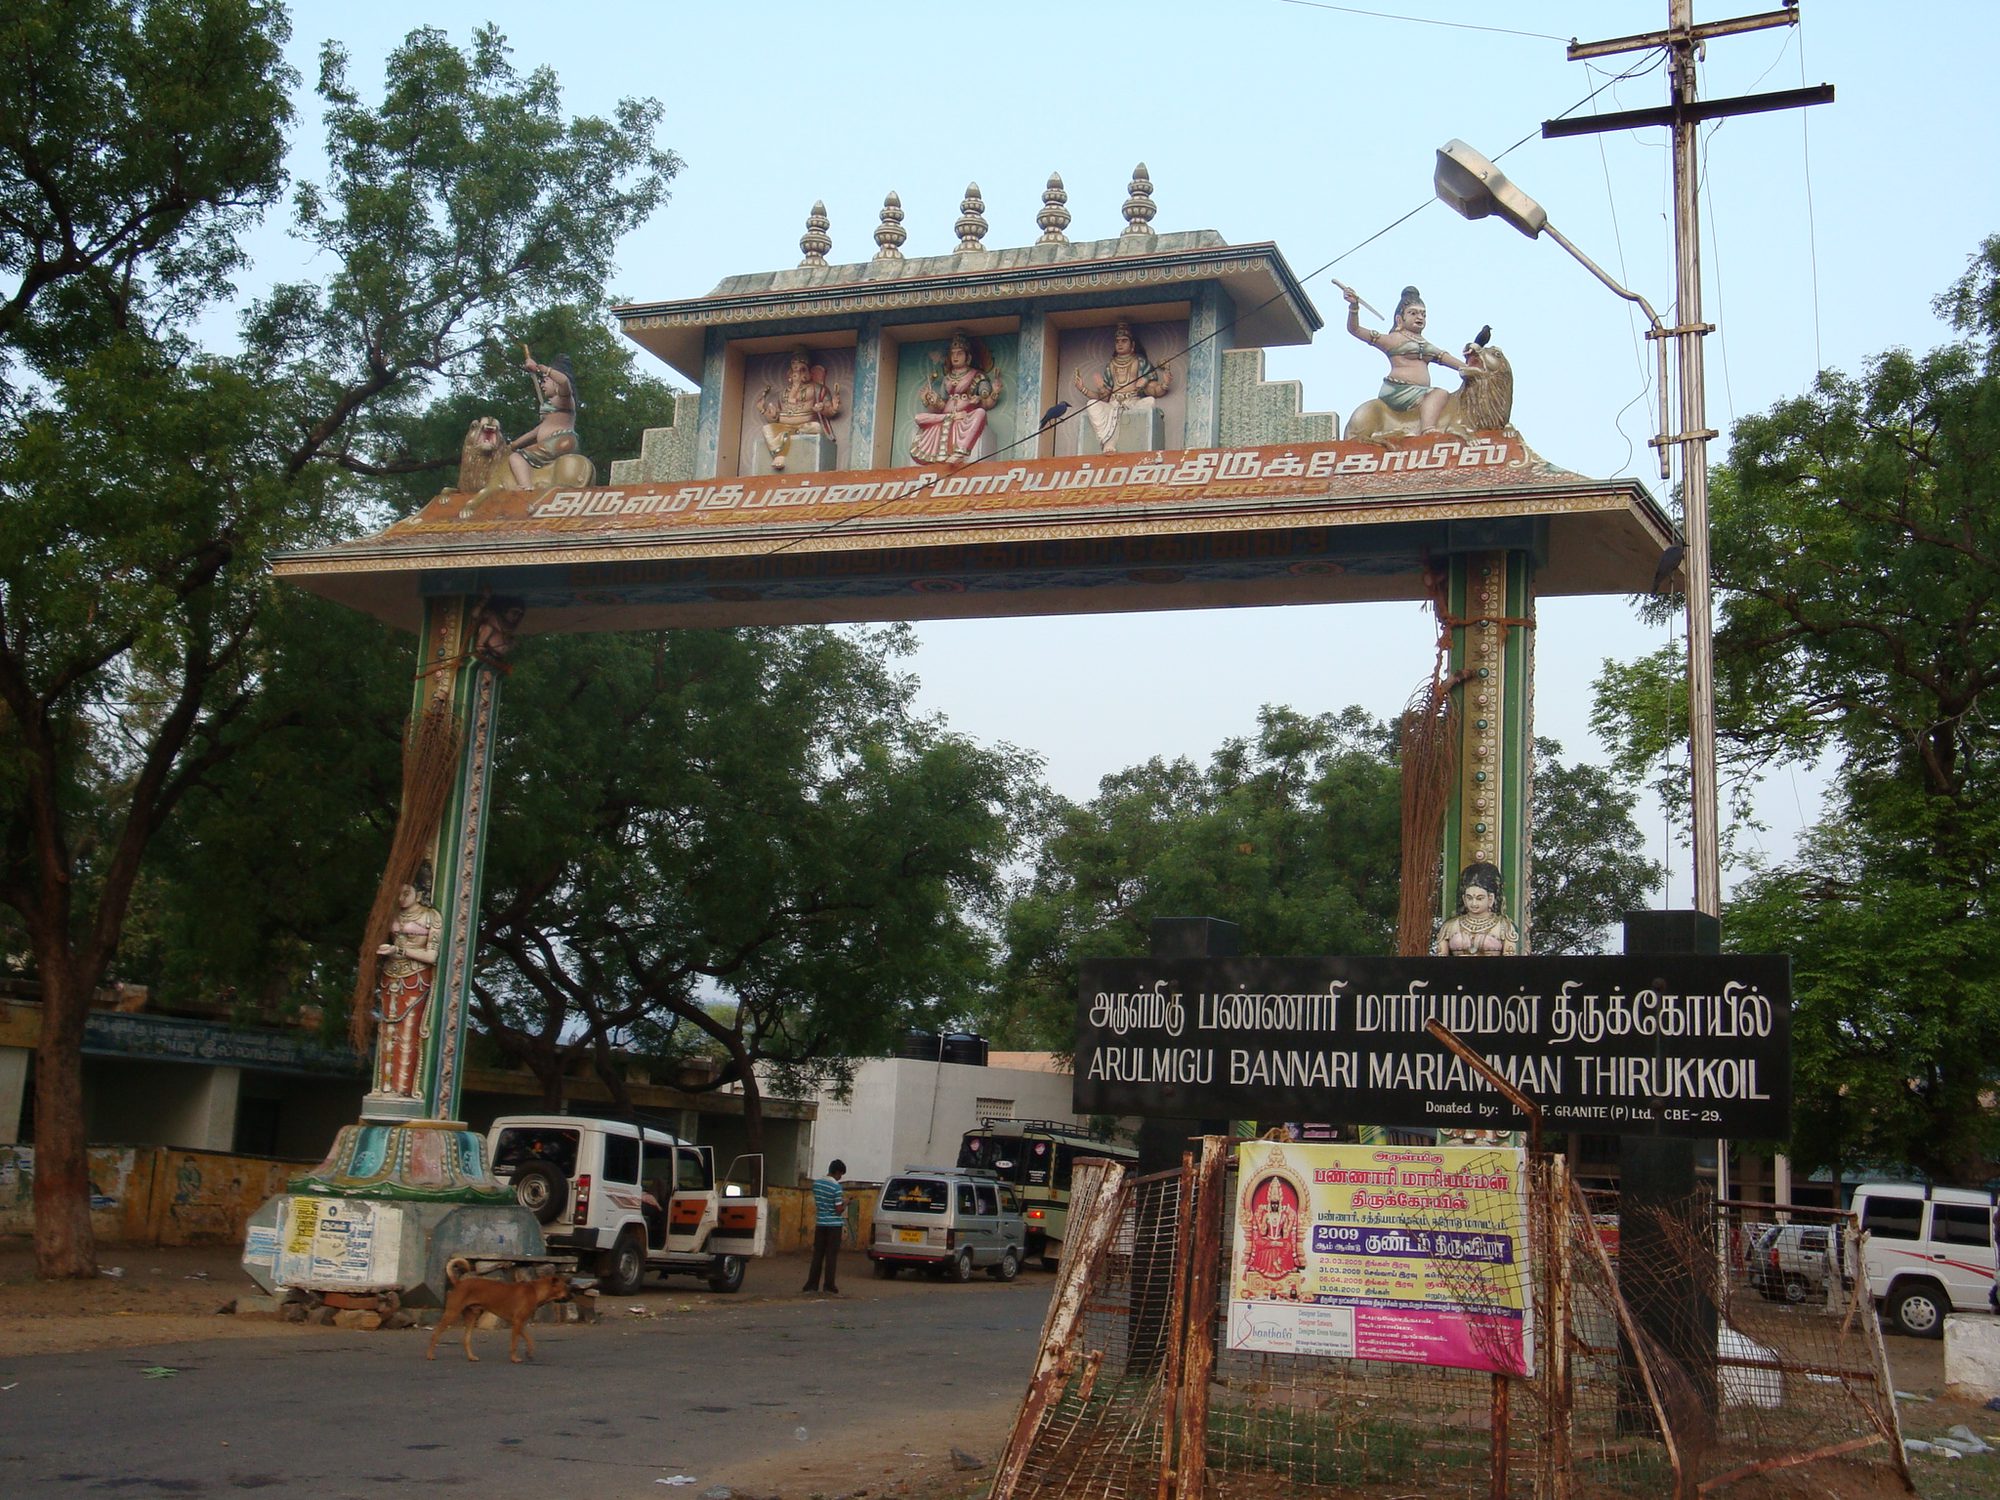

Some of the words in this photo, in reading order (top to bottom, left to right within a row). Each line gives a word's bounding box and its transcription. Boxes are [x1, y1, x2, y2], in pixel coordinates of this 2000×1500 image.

[533, 485, 744, 518] அருள்மிகு
[744, 472, 937, 508] பண்ணாரி
[930, 455, 1176, 498] மாரியம்மன்
[1168, 438, 1508, 486] திருக்கோயில்
[1089, 980, 1186, 1037] அருள்மிகு
[1198, 980, 1349, 1032] பண்ணாரி
[1355, 980, 1542, 1034] மாரியம்மன்
[1548, 980, 1773, 1045] திருக்கோயில்
[1088, 1047, 1213, 1084] ARULMIGU
[1230, 1049, 1358, 1088] BANNARI
[1369, 1051, 1562, 1095] MARIAMMAN
[1574, 1055, 1771, 1100] THIRUKKOIL
[1425, 1101, 1472, 1115] Donated
[1479, 1102, 1499, 1118] by:
[1554, 1105, 1609, 1119] GRANITE
[1610, 1104, 1629, 1120] (P)
[1631, 1107, 1656, 1120] Ltd.
[1313, 1161, 1398, 1187] பண்ணாரி
[1401, 1167, 1509, 1191] மாரியம்மன்
[1351, 1188, 1469, 1210] திருக்கோயில்
[1318, 1227, 1359, 1241] 2009
[1365, 1230, 1431, 1254] குண்டம்
